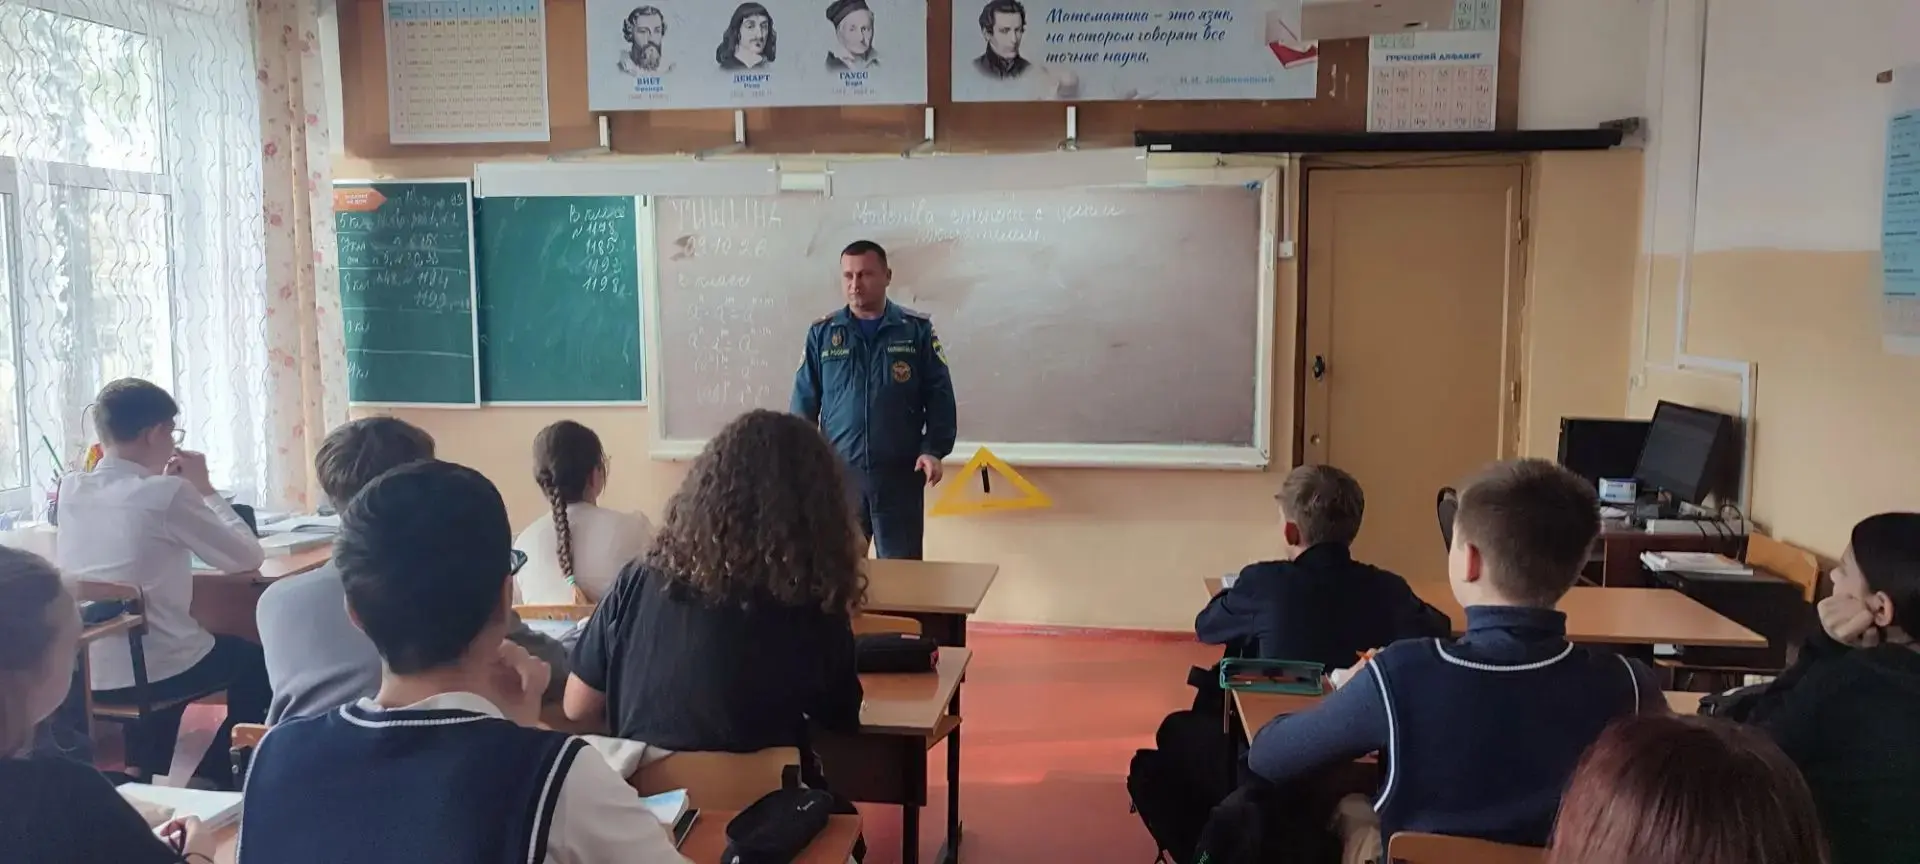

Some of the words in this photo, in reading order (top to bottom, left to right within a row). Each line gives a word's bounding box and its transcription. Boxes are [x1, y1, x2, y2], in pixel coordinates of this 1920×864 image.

[1046, 8, 1149, 23] Математика
[1168, 10, 1195, 22] это
[1198, 10, 1234, 26] язык,
[1046, 32, 1064, 42] на
[1068, 31, 1134, 48] котором
[1138, 26, 1198, 46] говорят
[1202, 25, 1226, 41] все
[1046, 52, 1099, 63] точные
[733, 74, 771, 83] ДЕКАРТ
[839, 71, 869, 80] ГАУСС
